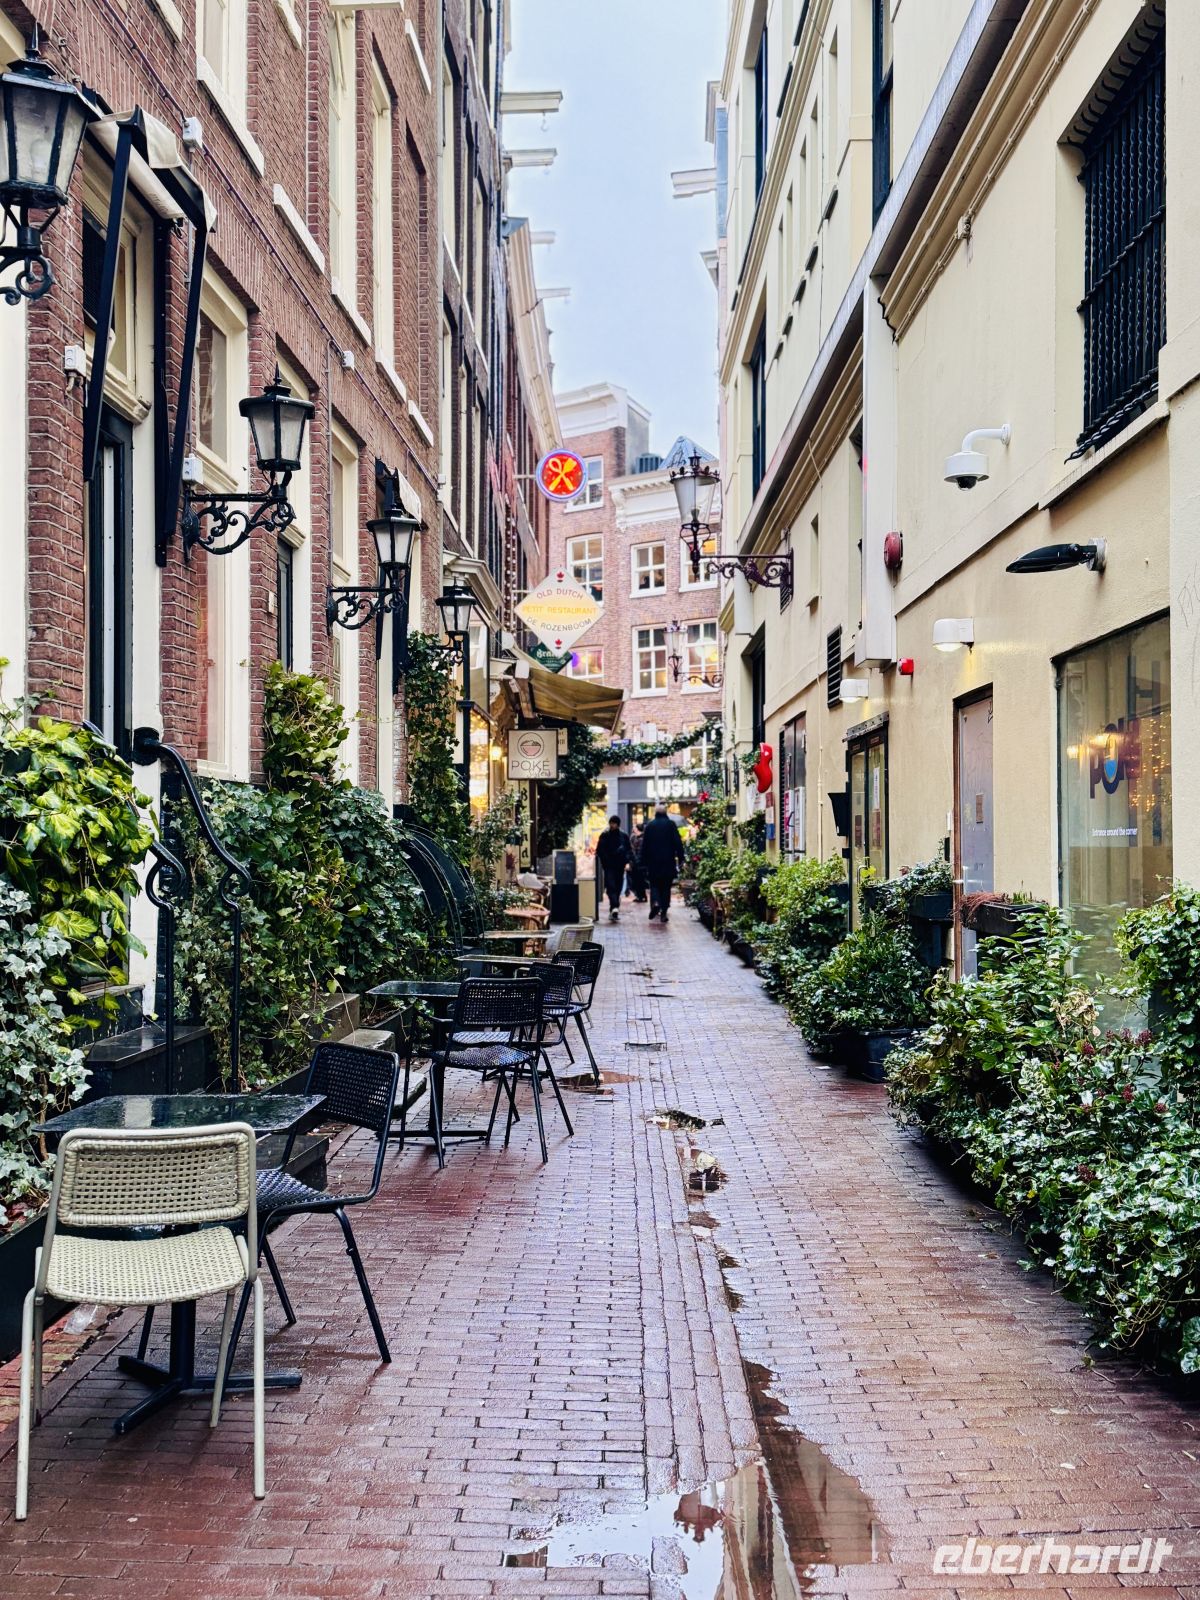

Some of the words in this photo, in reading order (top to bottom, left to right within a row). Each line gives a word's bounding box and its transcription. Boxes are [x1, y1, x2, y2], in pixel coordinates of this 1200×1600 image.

[537, 589, 553, 599] OLD
[557, 588, 583, 599] DUTCH
[527, 617, 537, 626] DE
[541, 618, 592, 631] ROZENBOOM
[646, 778, 698, 798] LUSH
